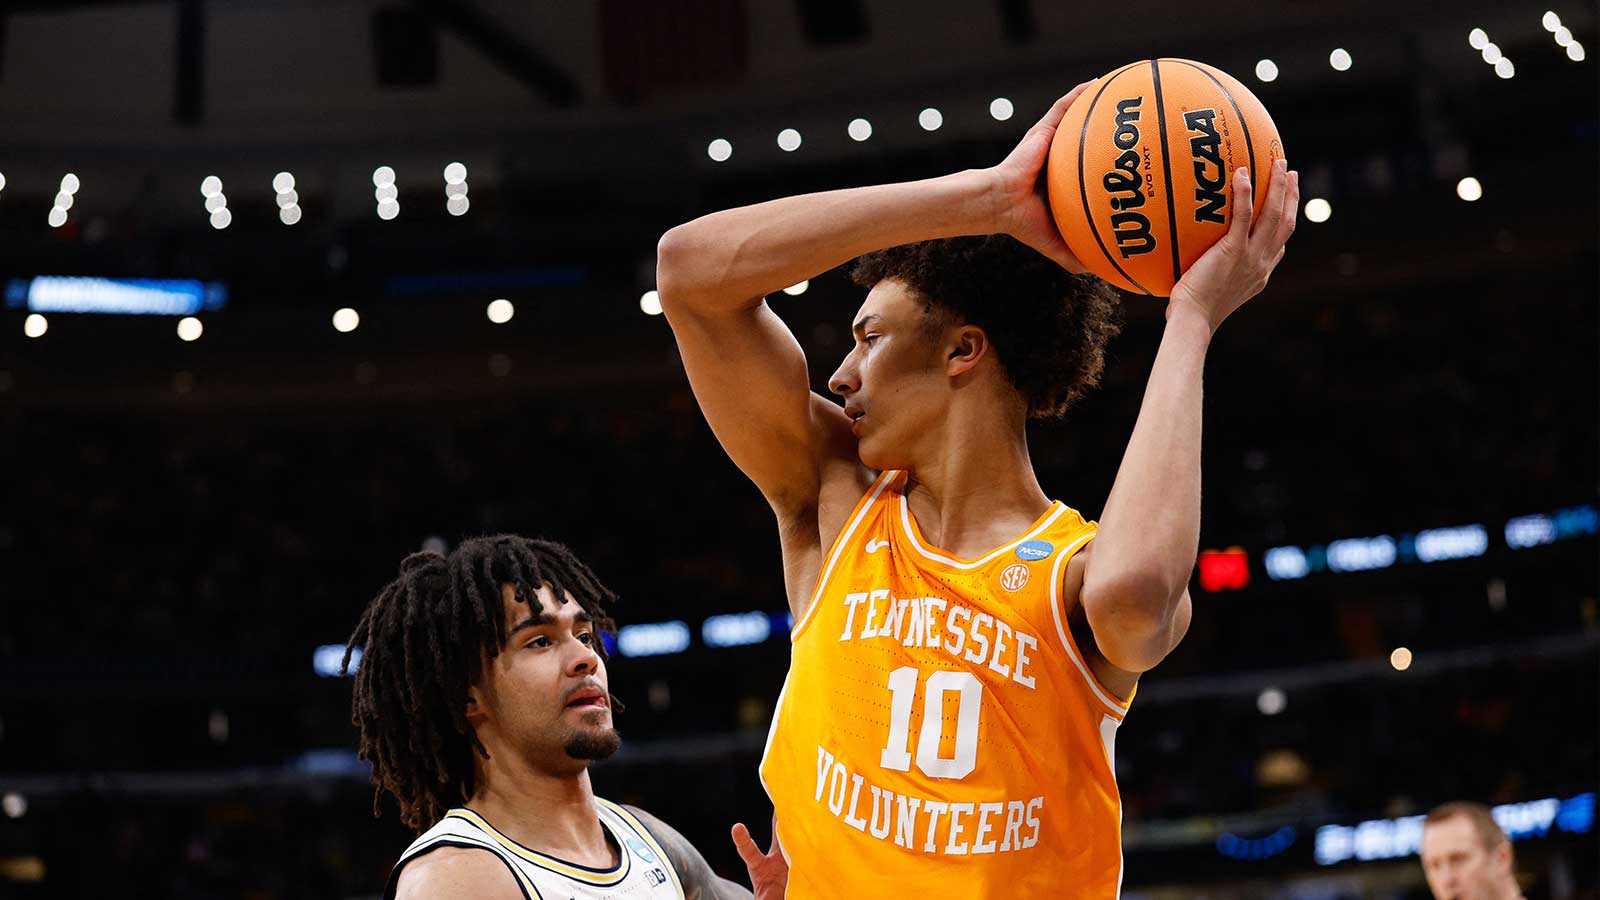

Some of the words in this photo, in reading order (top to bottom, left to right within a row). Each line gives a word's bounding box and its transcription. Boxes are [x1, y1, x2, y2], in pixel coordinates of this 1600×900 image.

[1219, 109, 1230, 136] BALL
[1225, 139, 1234, 172] GAME
[1103, 96, 1157, 260] Wilson
[1143, 146, 1151, 171] NXT
[1145, 172, 1154, 198] EVO
[1184, 108, 1227, 224] NCAA
[1003, 566, 1027, 589] SEC
[838, 589, 1038, 689] TENNESSEE
[880, 665, 984, 780] 10
[814, 744, 1046, 857] VOLUNTEERS
